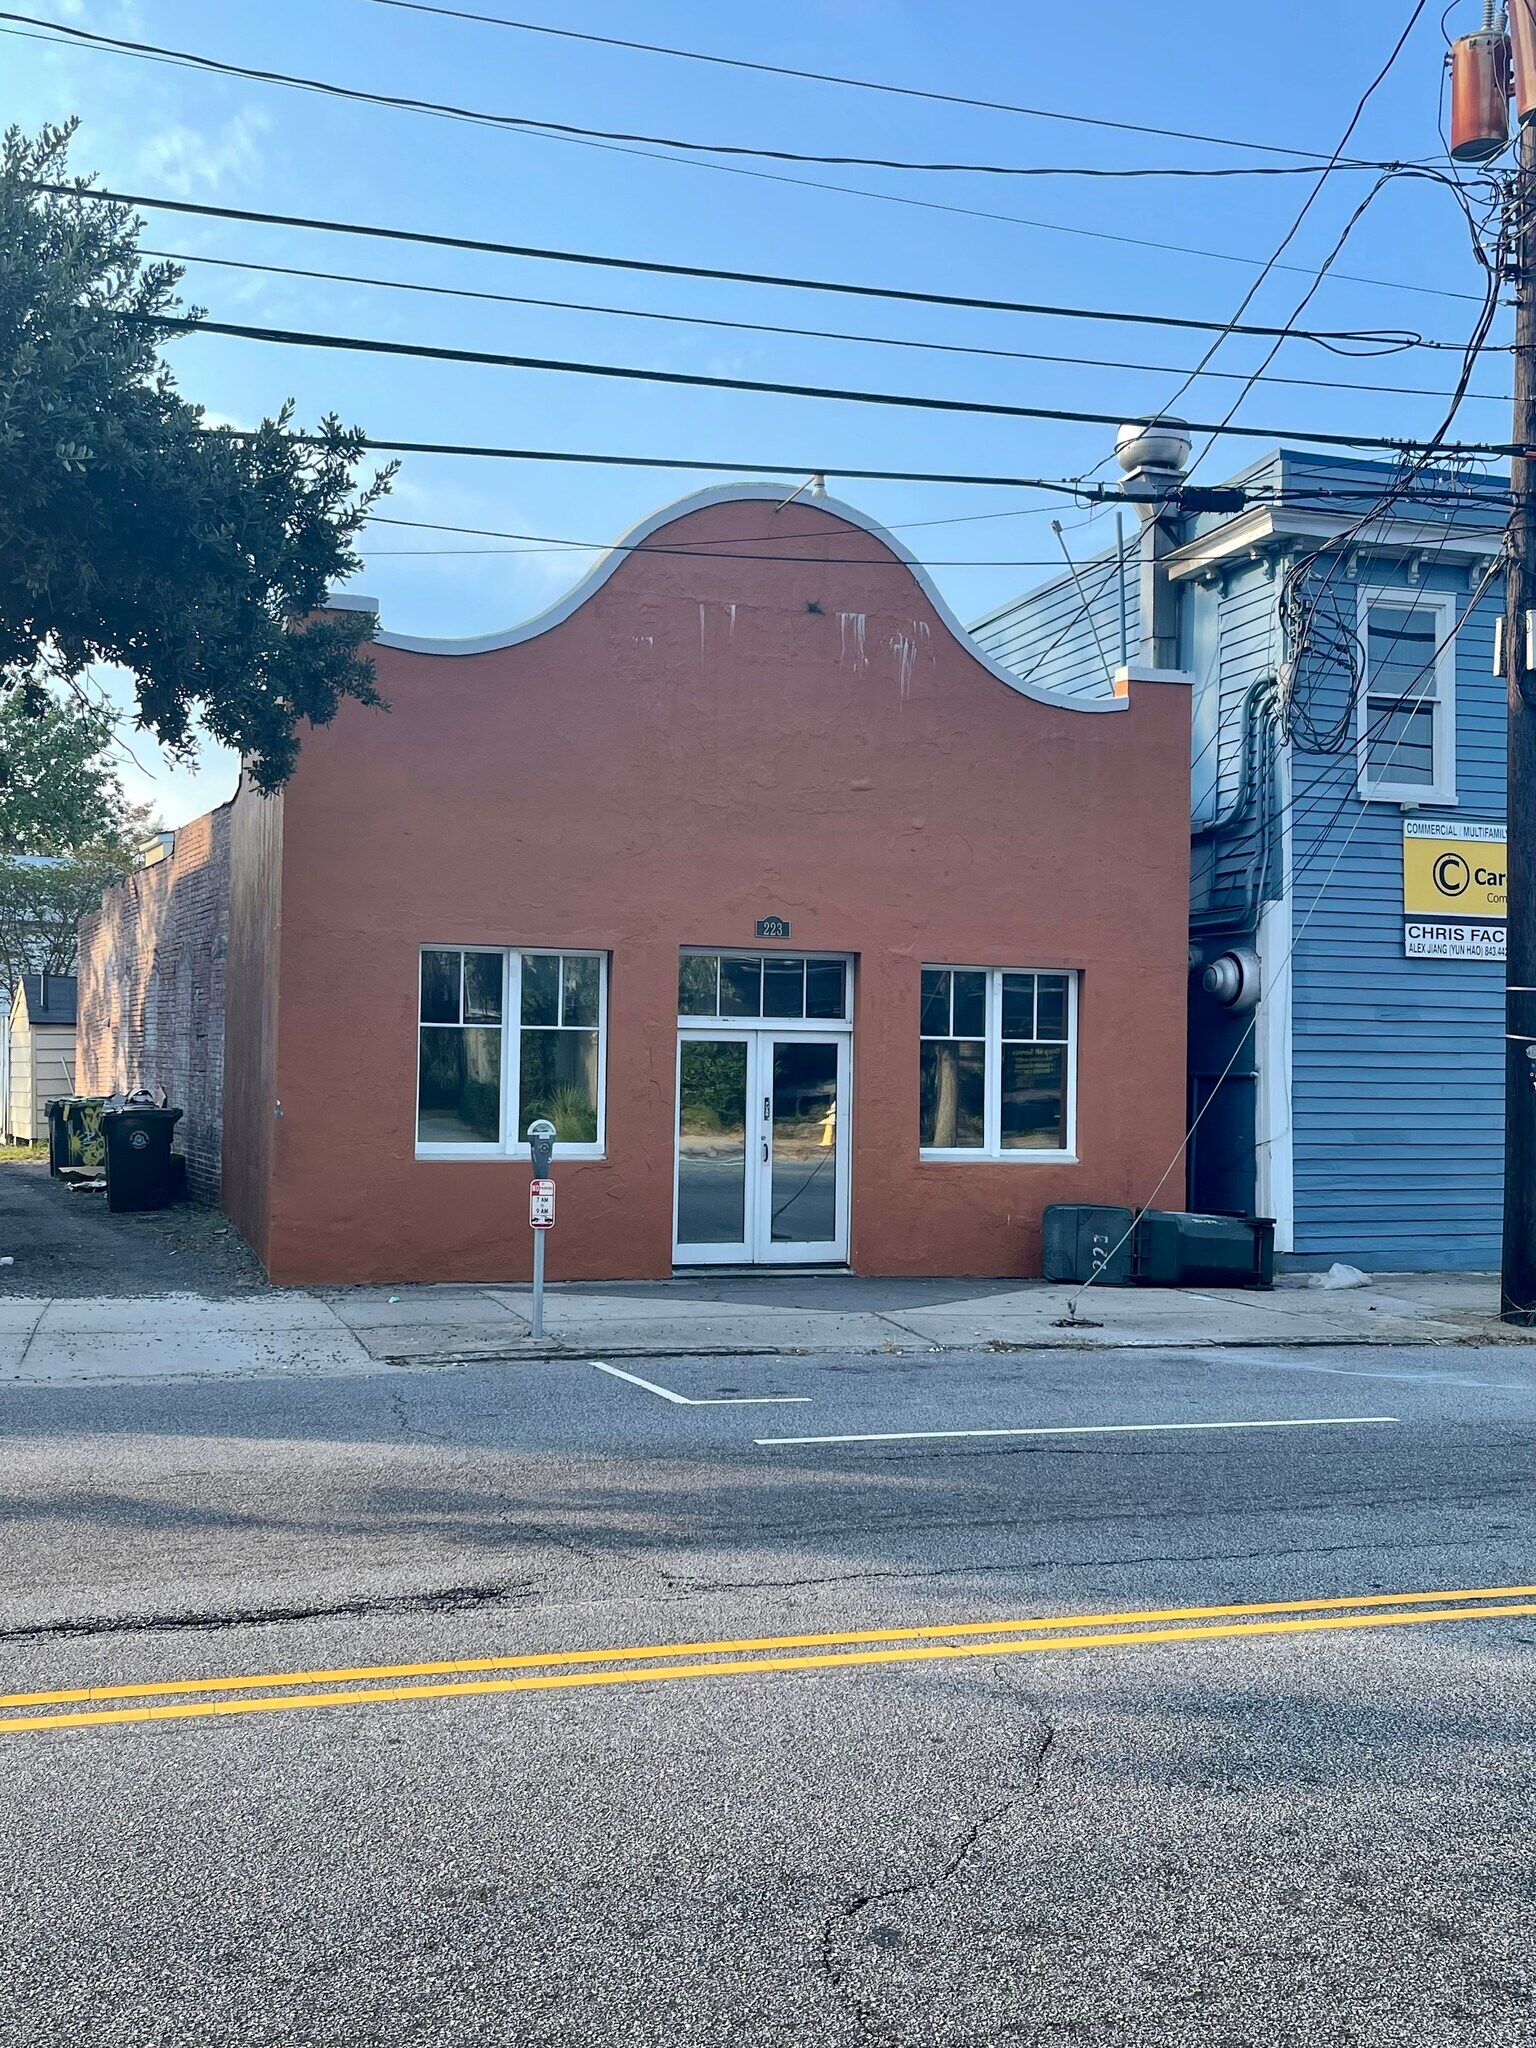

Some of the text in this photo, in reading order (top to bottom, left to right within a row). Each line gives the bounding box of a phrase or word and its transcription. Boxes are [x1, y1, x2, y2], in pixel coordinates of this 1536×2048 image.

[1406, 823, 1458, 836] COMMERCIAL
[1474, 868, 1507, 886] Car
[763, 922, 783, 936] 223
[1408, 926, 1505, 943] CHRIS FAC
[1409, 943, 1426, 953] ALEX
[1427, 943, 1448, 955] JIANG
[1449, 944, 1465, 956] (YUN
[1466, 945, 1484, 957] HAO)
[1092, 1234, 1108, 1270] 223
